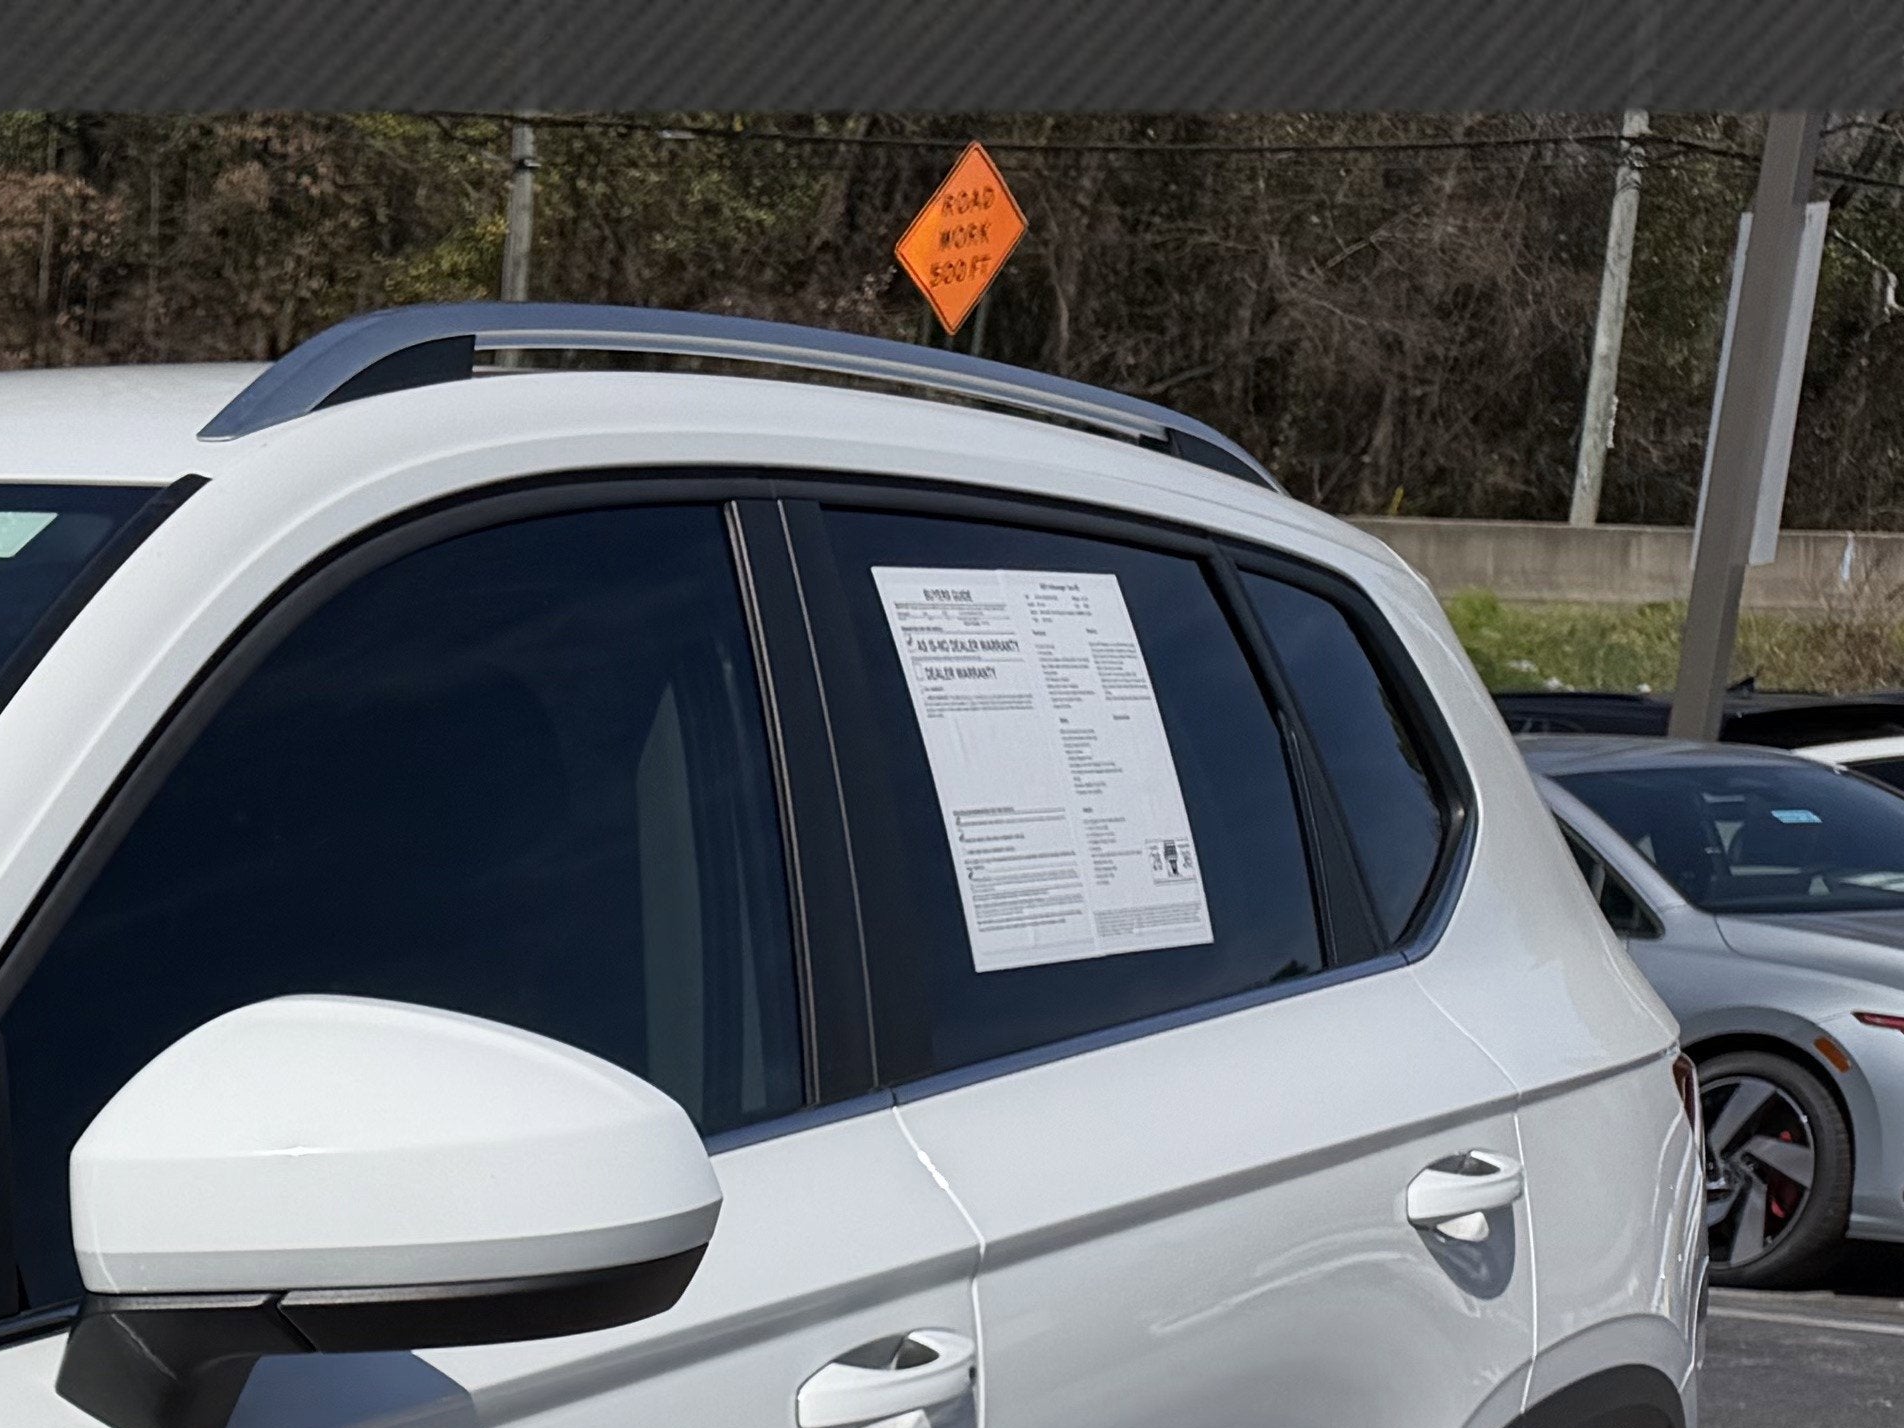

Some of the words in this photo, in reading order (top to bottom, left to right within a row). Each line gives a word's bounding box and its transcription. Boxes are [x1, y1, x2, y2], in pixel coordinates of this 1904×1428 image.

[941, 187, 996, 217] ROAD
[938, 221, 992, 252] WORK
[929, 260, 966, 288] 500
[970, 255, 993, 280] FT
